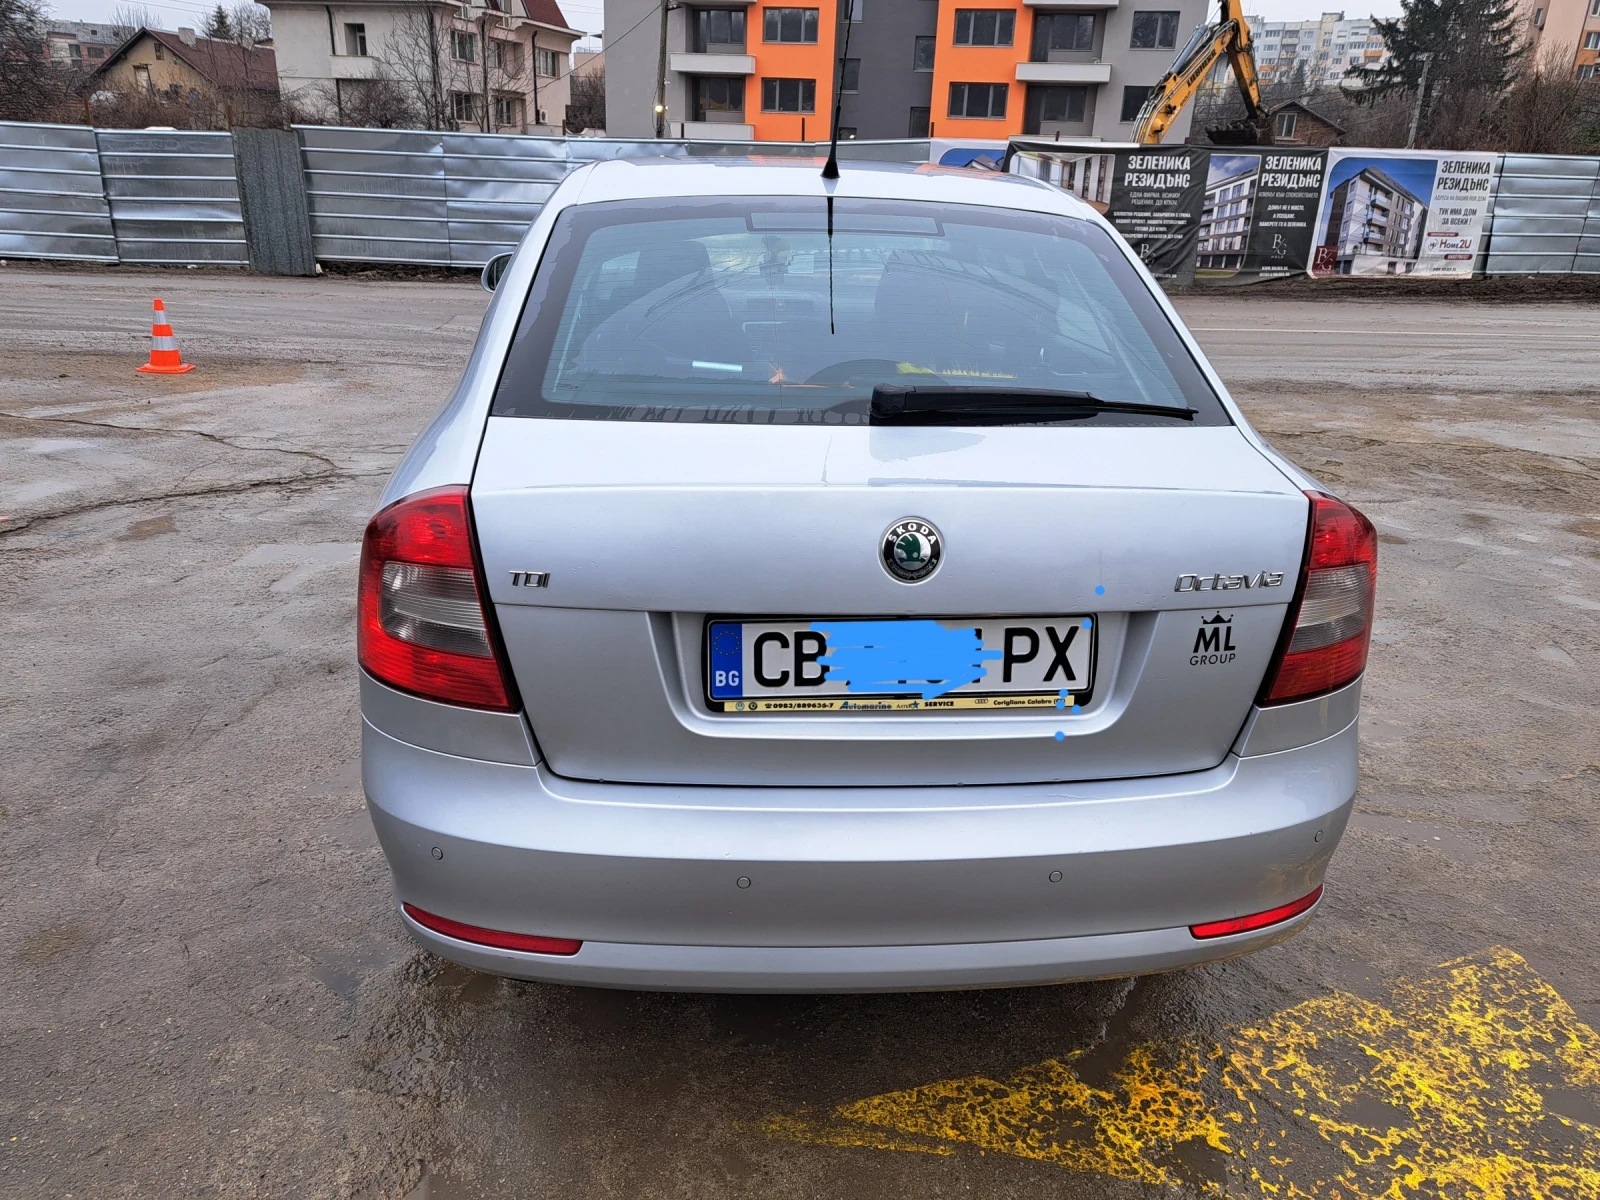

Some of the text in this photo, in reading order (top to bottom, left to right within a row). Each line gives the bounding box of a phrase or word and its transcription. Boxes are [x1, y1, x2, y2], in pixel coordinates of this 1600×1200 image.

[1128, 155, 1191, 171] ЗЕЛЕНИКА
[1265, 155, 1322, 171] ЗЕЛЕНИКА
[1441, 160, 1491, 175] ЗЕЛЕНИКА
[1124, 172, 1191, 189] РЕЗИДЪНС
[1260, 173, 1321, 189] РЕЗИДЪНС
[1436, 177, 1490, 193] РЕЗИДЪНС
[1438, 207, 1477, 217] ТУК ИМА ДОМ
[1441, 217, 1449, 225] ЗА
[508, 570, 551, 588] TDI
[1173, 569, 1284, 592] Octavia
[1192, 626, 1236, 653] ML
[1189, 653, 1236, 666] GROUP
[714, 670, 740, 687] BG
